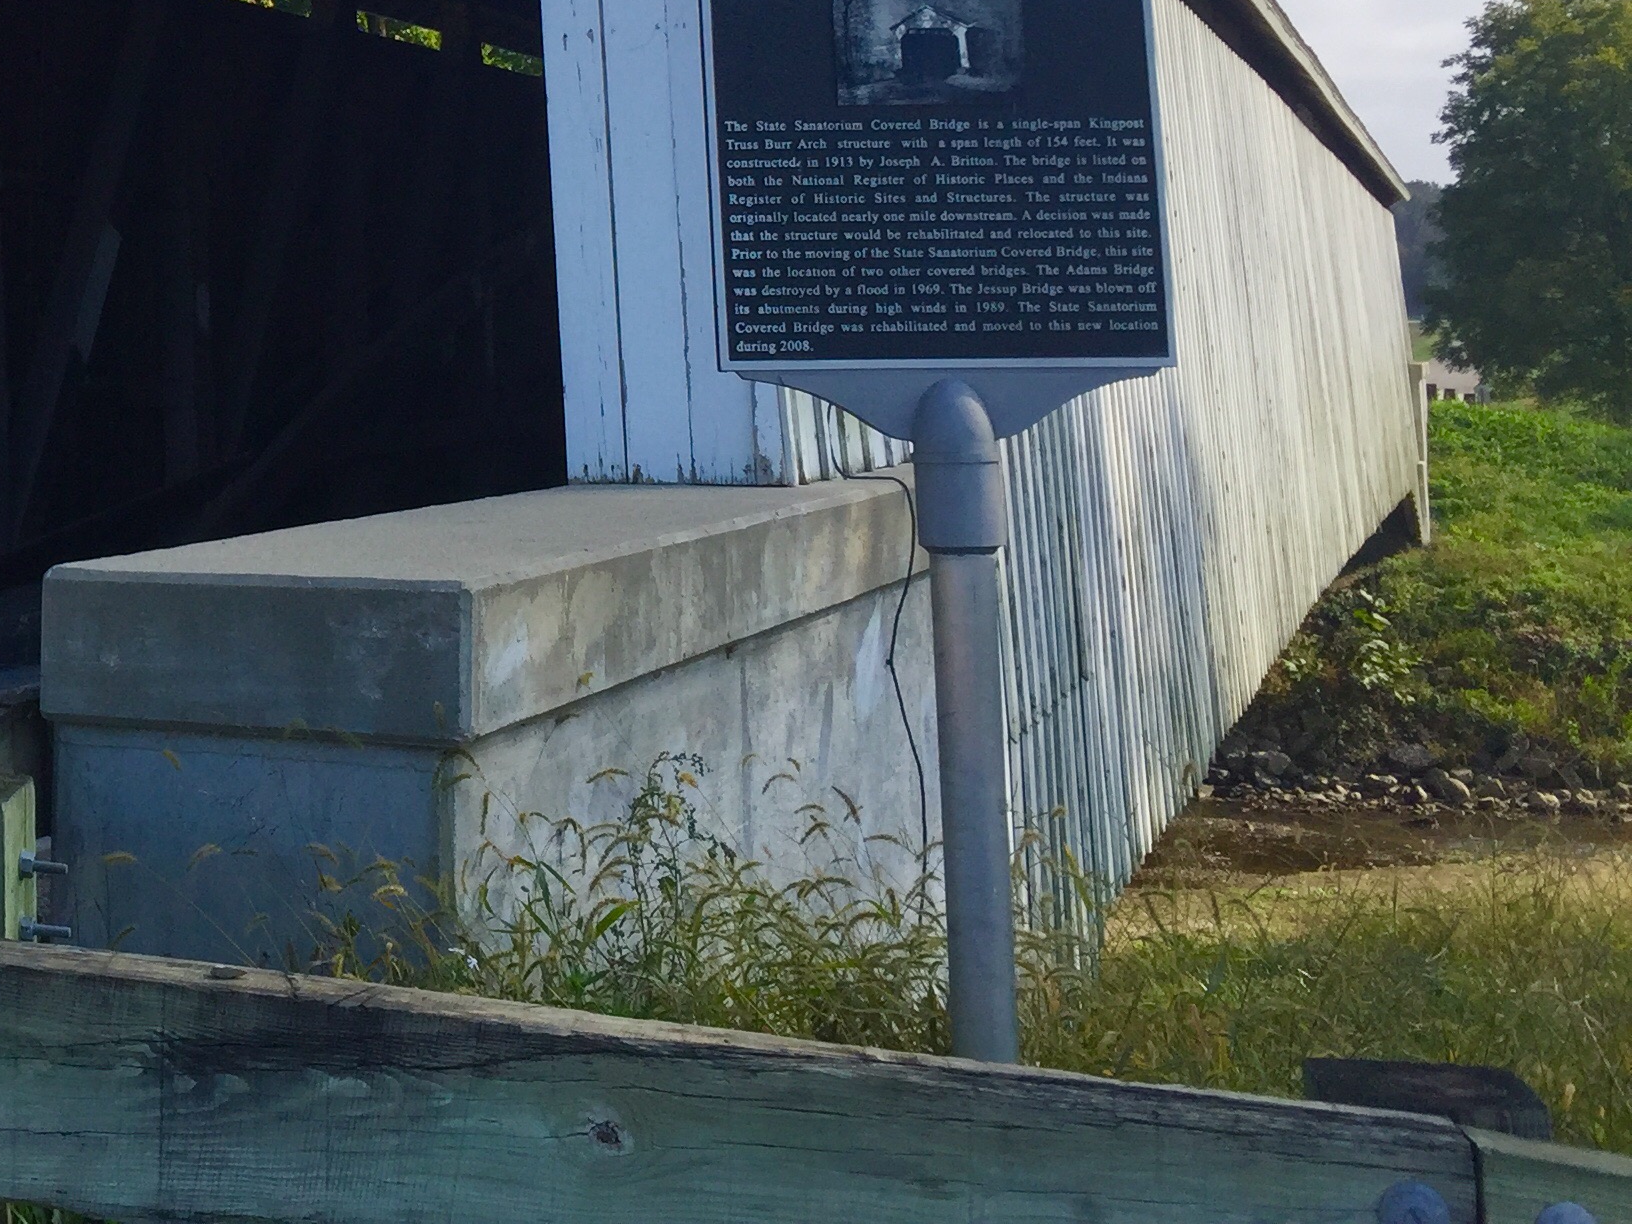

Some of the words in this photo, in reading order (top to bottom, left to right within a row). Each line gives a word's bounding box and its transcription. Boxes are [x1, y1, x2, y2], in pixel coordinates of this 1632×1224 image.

[723, 120, 749, 132] The
[755, 120, 788, 131] State
[794, 120, 864, 131] Sanatorium
[870, 119, 923, 130] Covered
[928, 119, 971, 132] Bridge
[978, 119, 990, 129] is
[996, 121, 1005, 129] a
[1011, 118, 1082, 132] single-span
[1088, 117, 1145, 131] Kingpost
[725, 139, 759, 150] Truss
[764, 139, 793, 150] Burr
[797, 138, 827, 149] Arch
[837, 139, 891, 148] structure
[901, 137, 928, 148] with
[938, 140, 946, 148] a
[950, 140, 979, 150] span
[984, 137, 1022, 150] length
[1027, 136, 1042, 147] of
[1047, 136, 1069, 147] 154
[1107, 136, 1117, 147] It
[1122, 138, 1146, 147] was
[806, 157, 820, 168] in
[825, 156, 854, 167] 1913
[858, 156, 874, 169] by
[879, 156, 921, 169] Joseph
[930, 155, 946, 166] A.
[950, 155, 999, 166] Britton.
[1003, 155, 1027, 166] The
[1031, 155, 1072, 168] bridge
[1076, 154, 1087, 165] is
[1092, 154, 1127, 166] listed
[1130, 156, 1147, 165] on
[727, 176, 756, 187] both
[764, 175, 783, 186] the
[792, 175, 845, 186] National
[853, 175, 905, 187] Register
[913, 174, 927, 185] of
[935, 173, 986, 184] Historic
[995, 173, 1034, 184] Places
[1043, 173, 1065, 184] and
[1073, 173, 1093, 183] the
[1102, 173, 1148, 183] Indiana
[729, 194, 782, 207] Register
[791, 193, 806, 204] of
[814, 193, 865, 204] Historic
[874, 192, 906, 203] Sites
[915, 192, 938, 203] and
[947, 192, 1017, 203] Structures.
[1025, 192, 1050, 202] The
[1059, 193, 1116, 202] structure
[1125, 193, 1150, 201] was
[729, 211, 790, 225] originally
[793, 211, 838, 222] located
[841, 211, 880, 225] nearly
[882, 213, 906, 222] one
[909, 210, 937, 221] mile
[940, 210, 1018, 221] downstream.
[1021, 210, 1032, 220] A
[1035, 209, 1088, 221] decision
[1091, 211, 1115, 220] was
[1118, 208, 1151, 220] made
[730, 230, 755, 241] that
[759, 230, 779, 241] the
[784, 231, 839, 241] structure
[843, 229, 882, 240] would
[886, 229, 902, 240] be
[906, 228, 985, 240] rehabilitated
[989, 228, 1012, 239] and
[1017, 227, 1075, 239] relocated
[1079, 229, 1092, 238] to
[1097, 227, 1121, 238] this
[1126, 227, 1152, 238] site.
[730, 248, 764, 260] Prior
[765, 249, 779, 259] to
[781, 248, 802, 259] the
[804, 248, 852, 262] moving
[853, 247, 869, 258] of
[870, 247, 891, 258] the
[893, 247, 925, 258] State
[927, 246, 998, 258] Sanatorium
[1000, 246, 1053, 257] Covered
[1104, 245, 1128, 257] this
[1131, 245, 1154, 256] site
[732, 269, 757, 278] was
[761, 267, 781, 278] the
[787, 266, 837, 277] location
[841, 265, 857, 277] of
[861, 267, 884, 277] two
[889, 265, 921, 276] other
[927, 265, 976, 276] covered
[980, 264, 1030, 278] bridges.
[1035, 264, 1060, 275] The
[1066, 264, 1108, 275] Adams
[1113, 264, 1155, 278] Bridge
[733, 288, 758, 297] was
[761, 284, 821, 298] destroyed
[824, 284, 841, 298] by
[844, 287, 853, 295] a
[857, 284, 889, 295] flood
[893, 284, 906, 295] in
[912, 283, 945, 295] 1969.
[948, 283, 973, 295] The
[977, 283, 1018, 296] Jessup
[1022, 283, 1064, 296] Bridge
[1068, 285, 1092, 294] was
[1095, 282, 1134, 294] blown
[1137, 281, 1158, 293] off
[734, 303, 751, 315] its
[757, 303, 820, 314] abutments
[827, 302, 868, 316] during
[875, 302, 903, 316] high
[910, 302, 947, 313] winds
[954, 301, 968, 313] in
[1017, 301, 1041, 312] The
[1049, 301, 1080, 312] State
[1087, 301, 1158, 312] Sanatorium
[735, 321, 787, 333] Covered
[793, 320, 835, 335] Bridge
[840, 323, 864, 332] was
[870, 320, 949, 332] rehabilitated
[954, 320, 977, 331] and
[982, 320, 1024, 331] moved
[1029, 322, 1042, 331] to
[1048, 320, 1072, 331] this
[1077, 322, 1103, 330] new
[1109, 319, 1159, 330] location
[735, 340, 777, 354] during
[779, 340, 815, 352] 2008.
